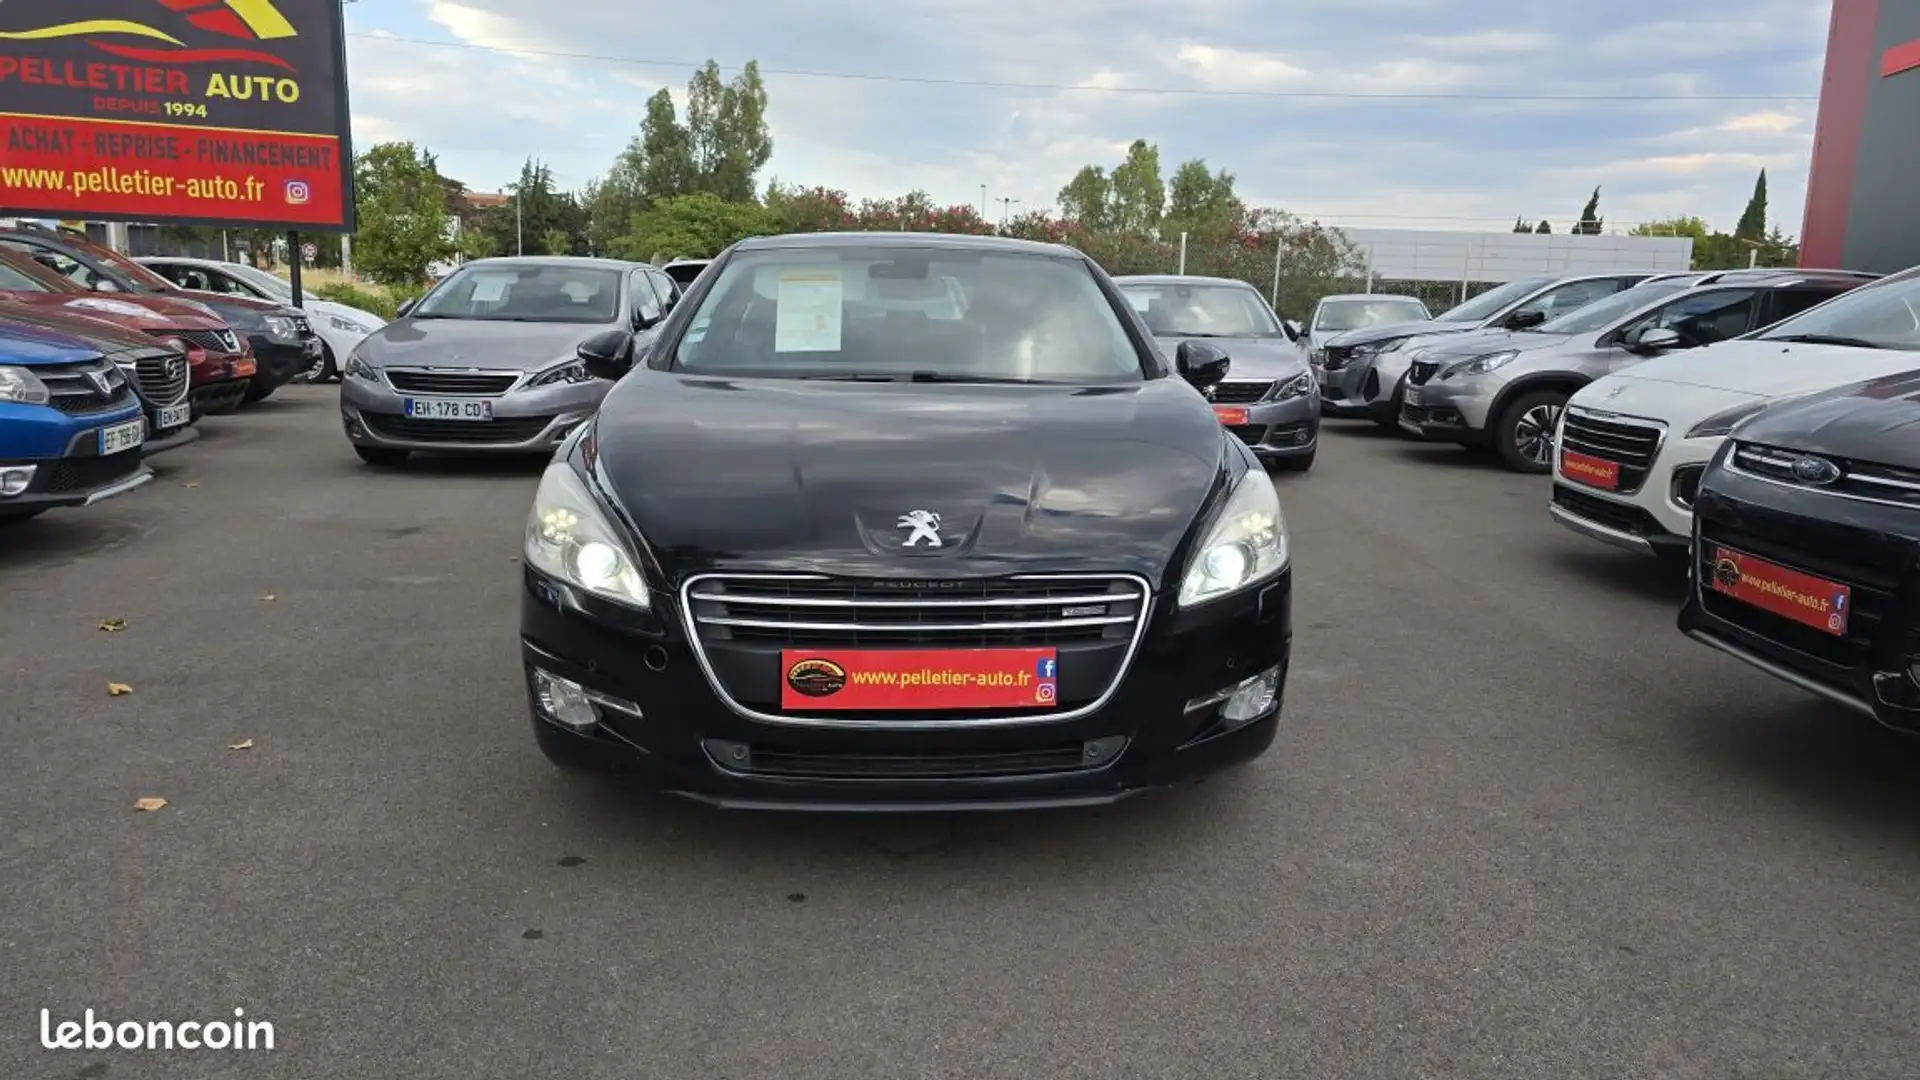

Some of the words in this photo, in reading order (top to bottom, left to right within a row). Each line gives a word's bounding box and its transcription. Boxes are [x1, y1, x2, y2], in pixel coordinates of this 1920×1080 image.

[0, 56, 190, 95] PELLETIER
[205, 73, 300, 103] AUTO
[93, 97, 160, 114] DEPUIS
[163, 101, 208, 118] 1994
[8, 126, 75, 151] ACHAT
[94, 132, 179, 160] REPRISE
[197, 140, 331, 169] FINANCEMENT
[1, 165, 264, 201] www.pelletier-auto.fr
[852, 669, 1032, 688] www.pelletier-auto.fr
